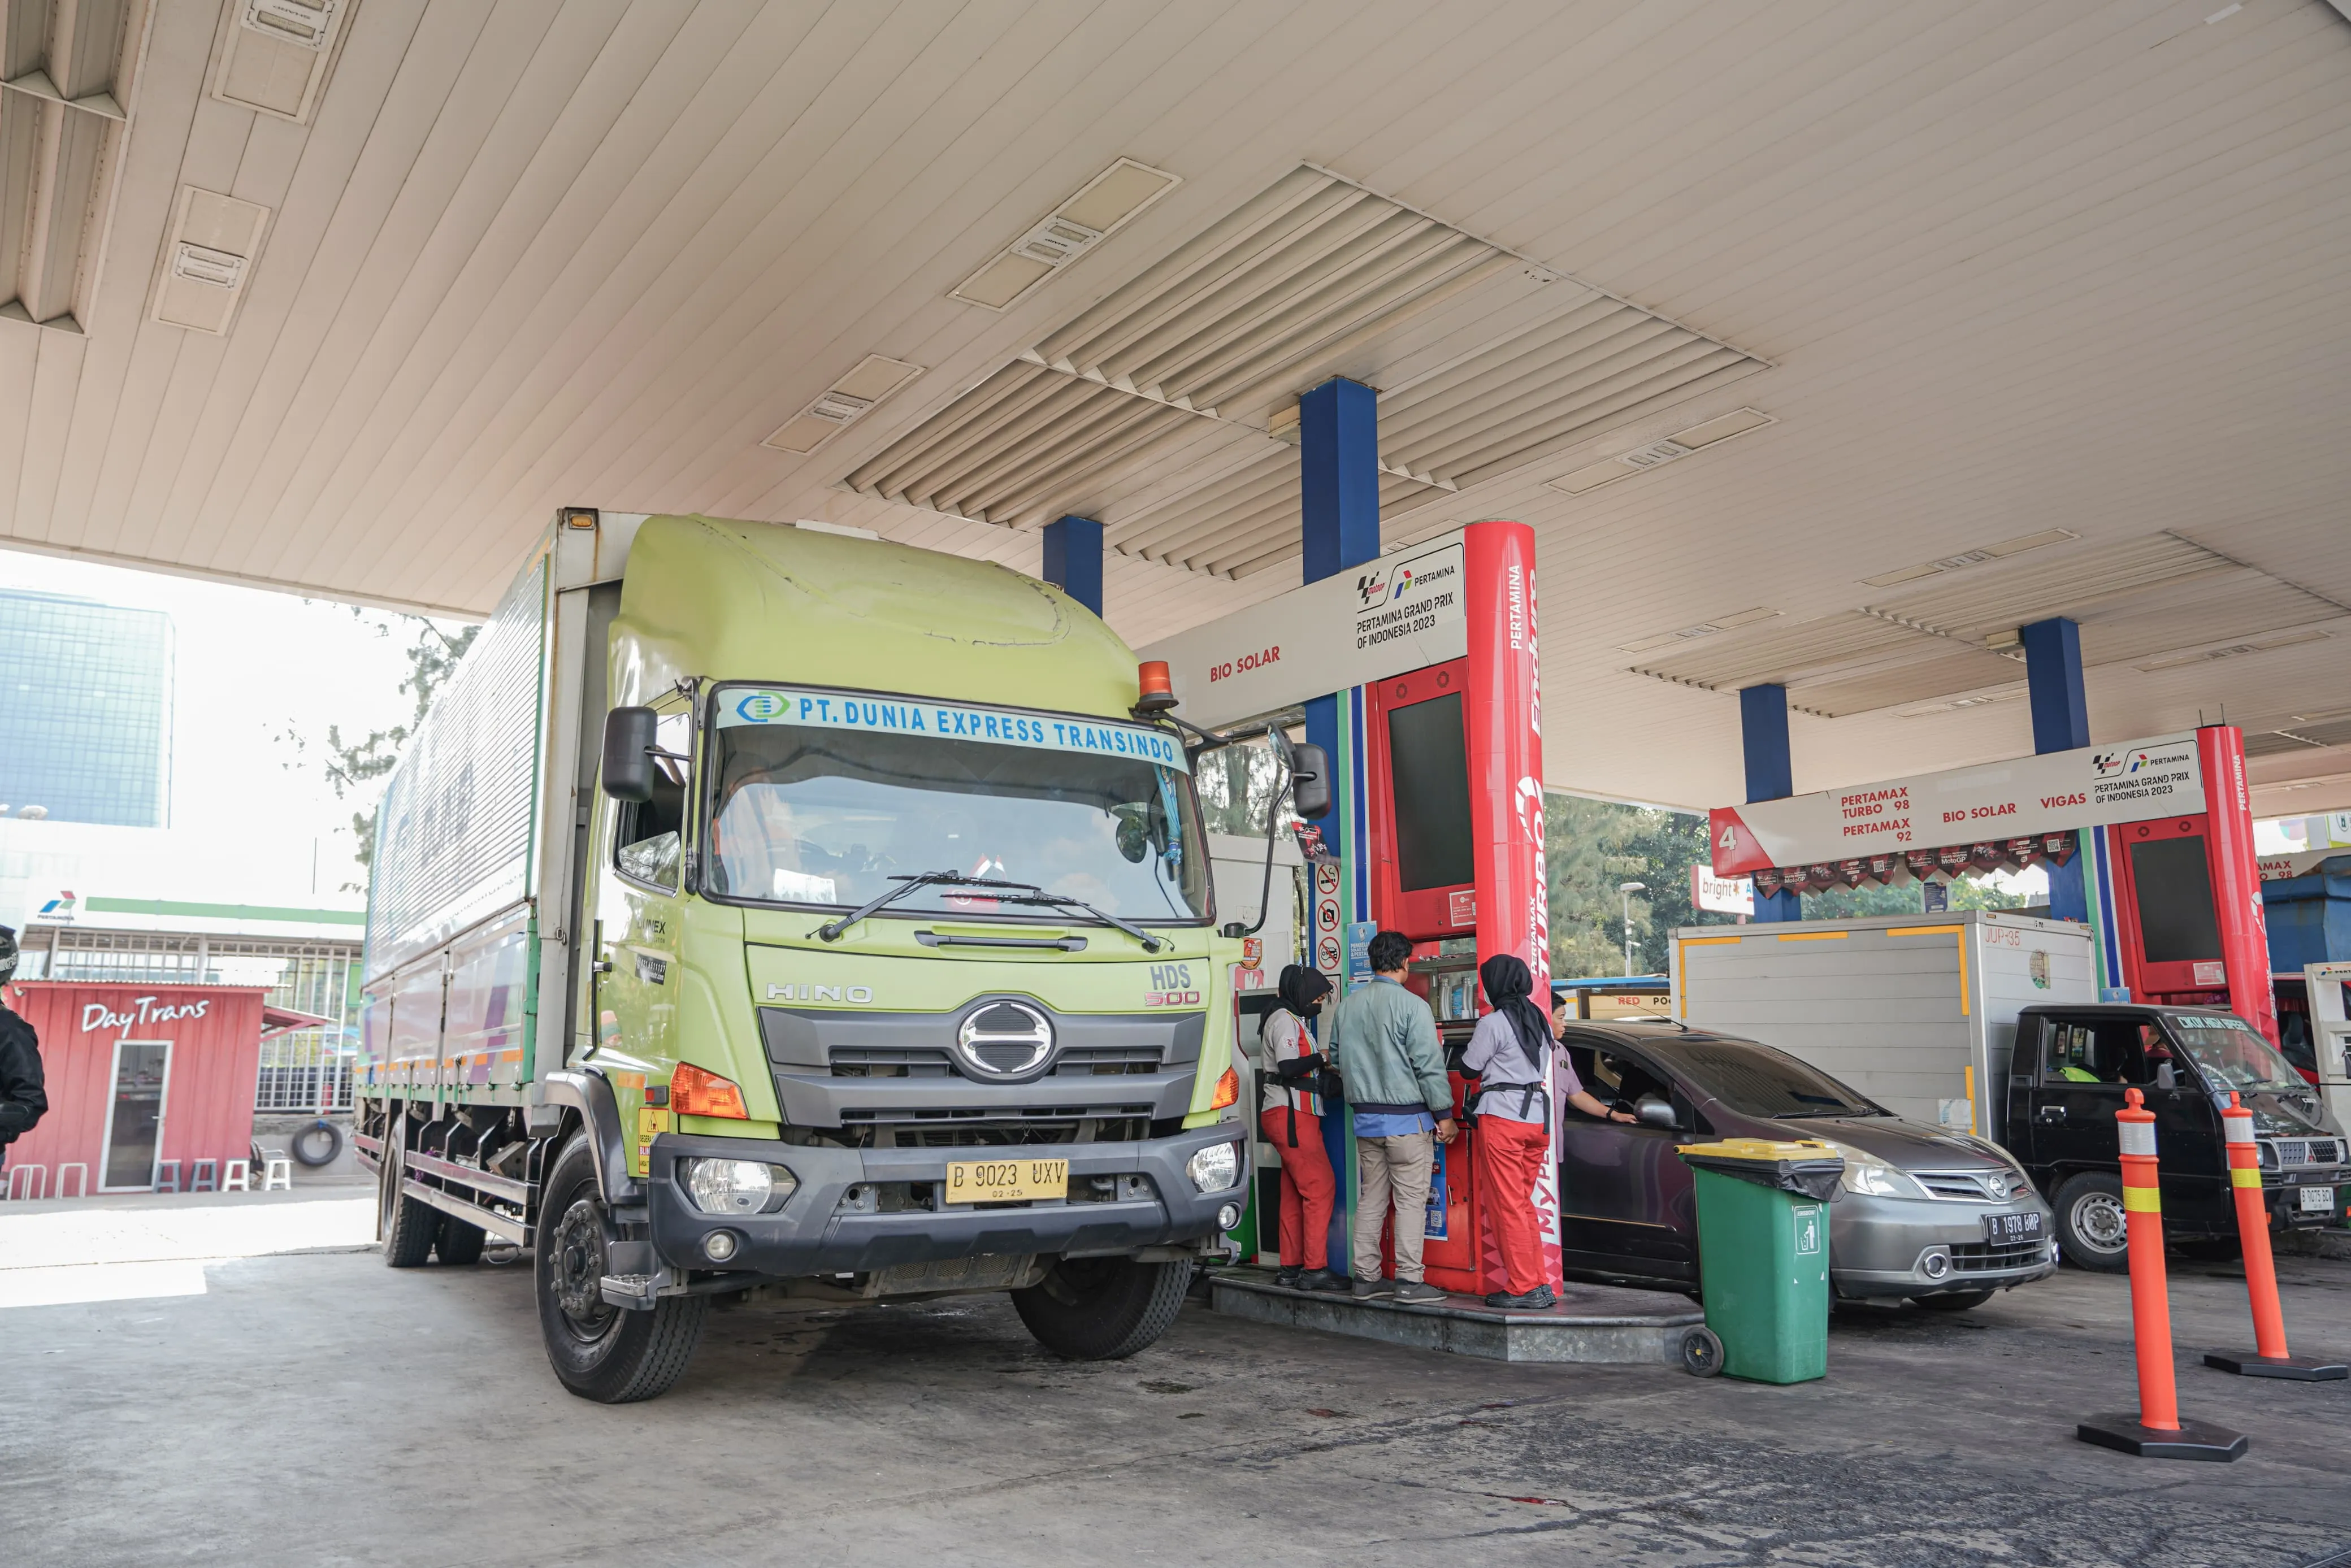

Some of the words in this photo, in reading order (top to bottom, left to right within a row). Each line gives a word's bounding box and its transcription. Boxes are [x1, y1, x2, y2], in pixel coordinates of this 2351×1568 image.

[1415, 565, 1455, 587] PERTAMINA
[1357, 609, 1402, 634] PERTAMINA
[1404, 599, 1432, 619] GRAND
[1434, 592, 1454, 609] PRIX
[1508, 565, 1522, 650] PERTAMINA
[1357, 635, 1367, 649] OF
[1369, 622, 1411, 646] INDONESIA
[1413, 614, 1435, 632] 2023
[1211, 663, 1231, 683] BIO
[1237, 646, 1280, 673] SOLAR
[1529, 569, 1541, 739] Enduro
[800, 698, 838, 723] PT.
[845, 701, 925, 731] DUNIA
[937, 710, 1044, 743] EXPRESS
[1053, 723, 1174, 762] TRANSINDO
[2150, 754, 2190, 766] PERTAMINA
[2094, 779, 2140, 793] PERTAMINA
[2141, 775, 2169, 786] GRAND
[2171, 771, 2190, 781] PRIX
[2233, 755, 2246, 811] PERTAMINA
[1841, 787, 1909, 807] PERTAMAX
[2040, 793, 2087, 809] VIGAS
[2096, 794, 2106, 803] OF
[2107, 789, 2149, 802] INDONESIA
[2152, 785, 2173, 796] 2023
[1842, 803, 1882, 819] TURBO
[1894, 800, 1910, 811] 98
[1943, 810, 1966, 823] BIO
[1971, 803, 2017, 819] SOLAR
[1719, 826, 1737, 850] 4
[1843, 818, 1911, 837] PERTAMAX
[1897, 831, 1912, 842] 92
[2279, 871, 2293, 879] 98
[1533, 810, 1549, 979] TURBO
[1703, 878, 1731, 900] bright
[1150, 964, 1191, 990] HDS
[767, 983, 873, 1003] HINO
[1145, 991, 1200, 1006] 500
[1618, 997, 1640, 1005] RED
[82, 996, 210, 1039] DayTrans
[954, 1166, 964, 1187] B
[975, 1164, 1017, 1187] 9023
[1033, 1162, 1065, 1184] UXV
[2302, 1190, 2306, 1202] B
[1992, 1218, 1998, 1235] B
[2003, 1215, 2023, 1233] 1978
